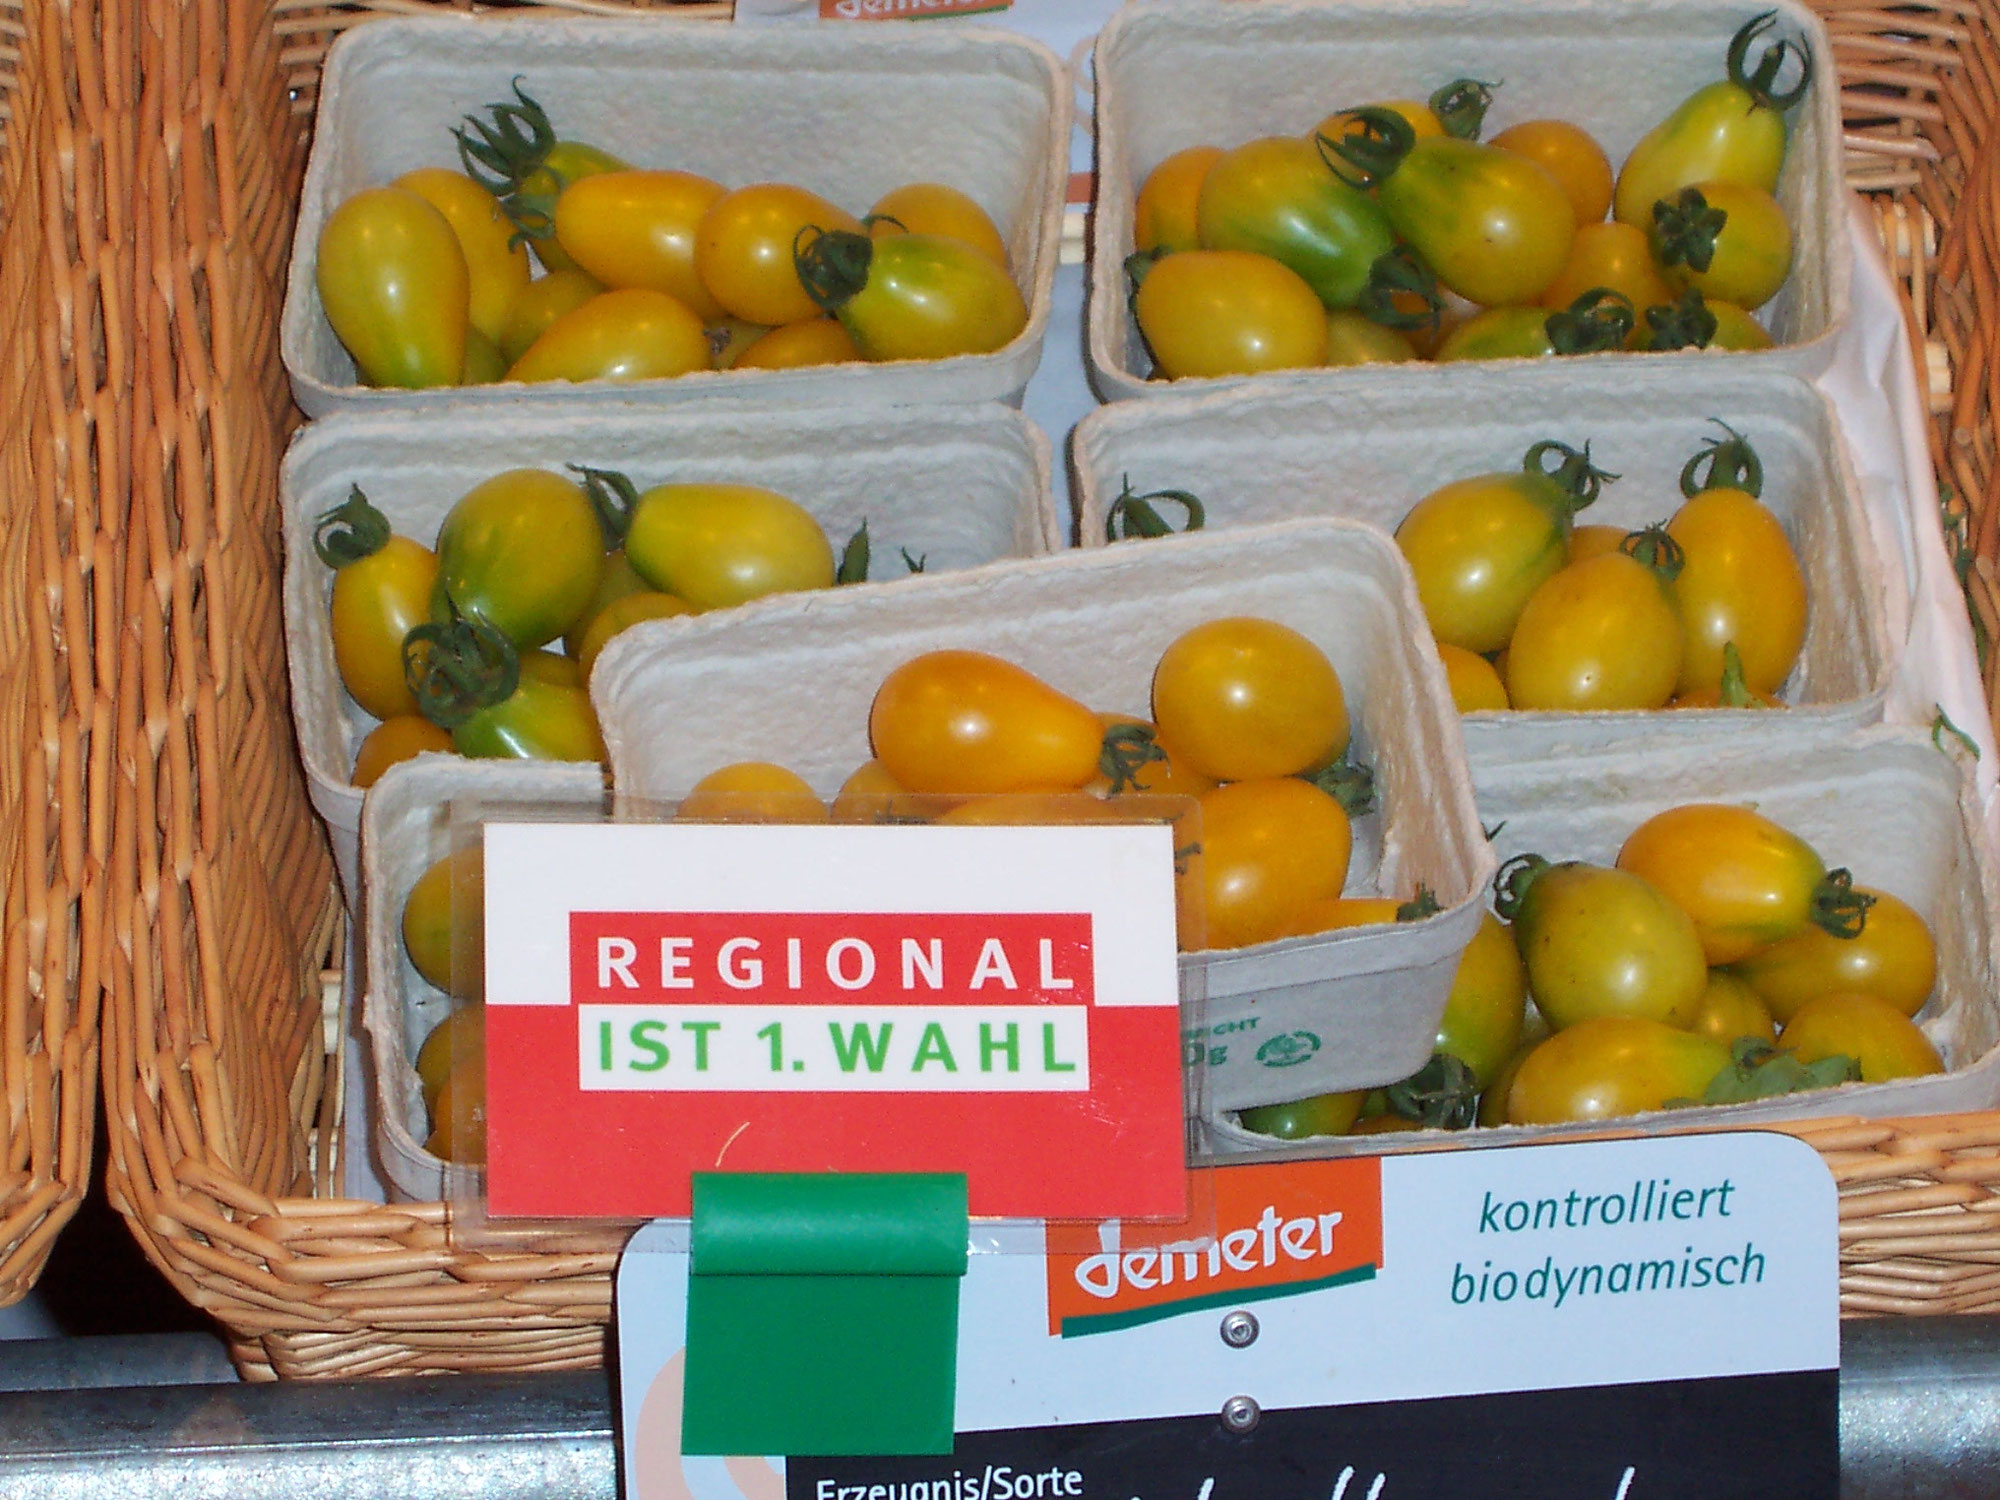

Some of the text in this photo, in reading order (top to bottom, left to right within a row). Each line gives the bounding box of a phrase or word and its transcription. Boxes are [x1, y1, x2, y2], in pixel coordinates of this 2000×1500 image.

[597, 937, 1074, 990] REGIONAL
[599, 1020, 1076, 1072] IST 1. WAHL
[1479, 1178, 1736, 1234] kontrolliert
[1074, 1205, 1343, 1299] demeter
[1450, 1242, 1766, 1308] biodynamisch
